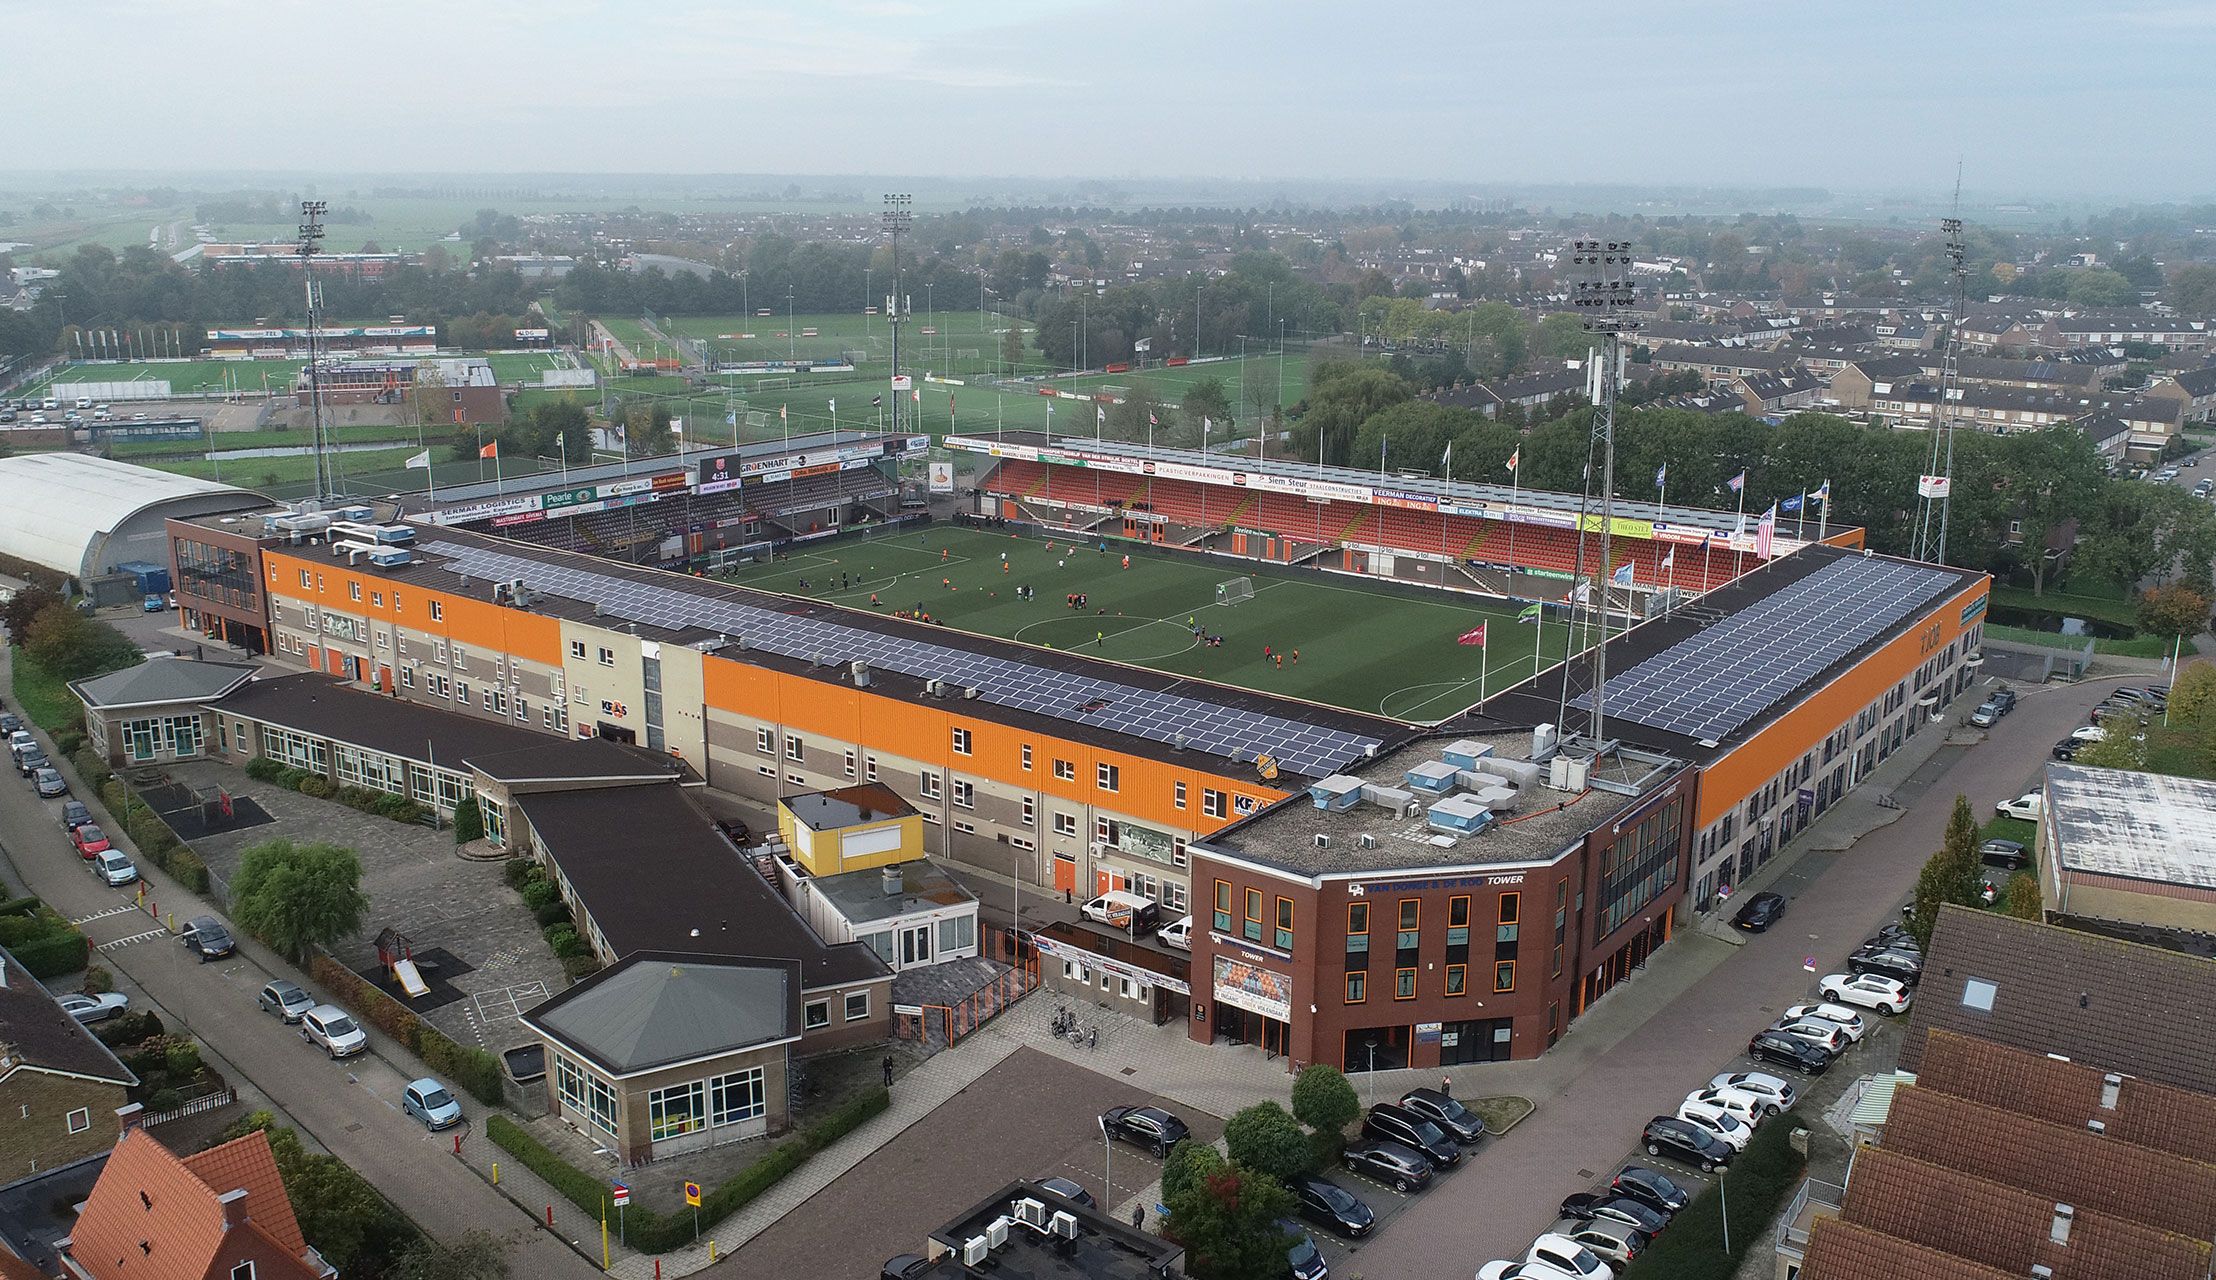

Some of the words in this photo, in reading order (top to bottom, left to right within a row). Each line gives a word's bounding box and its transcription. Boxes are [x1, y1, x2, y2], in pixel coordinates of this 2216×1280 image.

[741, 459, 788, 472] GROENHART
[712, 472, 729, 480] 4:31
[1268, 476, 1286, 486] Siem
[1288, 478, 1308, 488] Steur
[1310, 484, 1362, 494] STAALCONSTRUCTIES
[547, 494, 572, 503] Pearle
[1374, 490, 1404, 498] VEERMAN
[1377, 498, 1392, 506] ING
[442, 506, 477, 516] SERMAR
[482, 498, 526, 510] LOGISTICS
[1459, 508, 1482, 516] ELEKTRA
[1659, 532, 1680, 540] VROOM
[1368, 885, 1390, 893] VAN
[1444, 880, 1456, 888] DE
[1488, 876, 1524, 885] TOWER
[1241, 951, 1264, 962] TOWER
